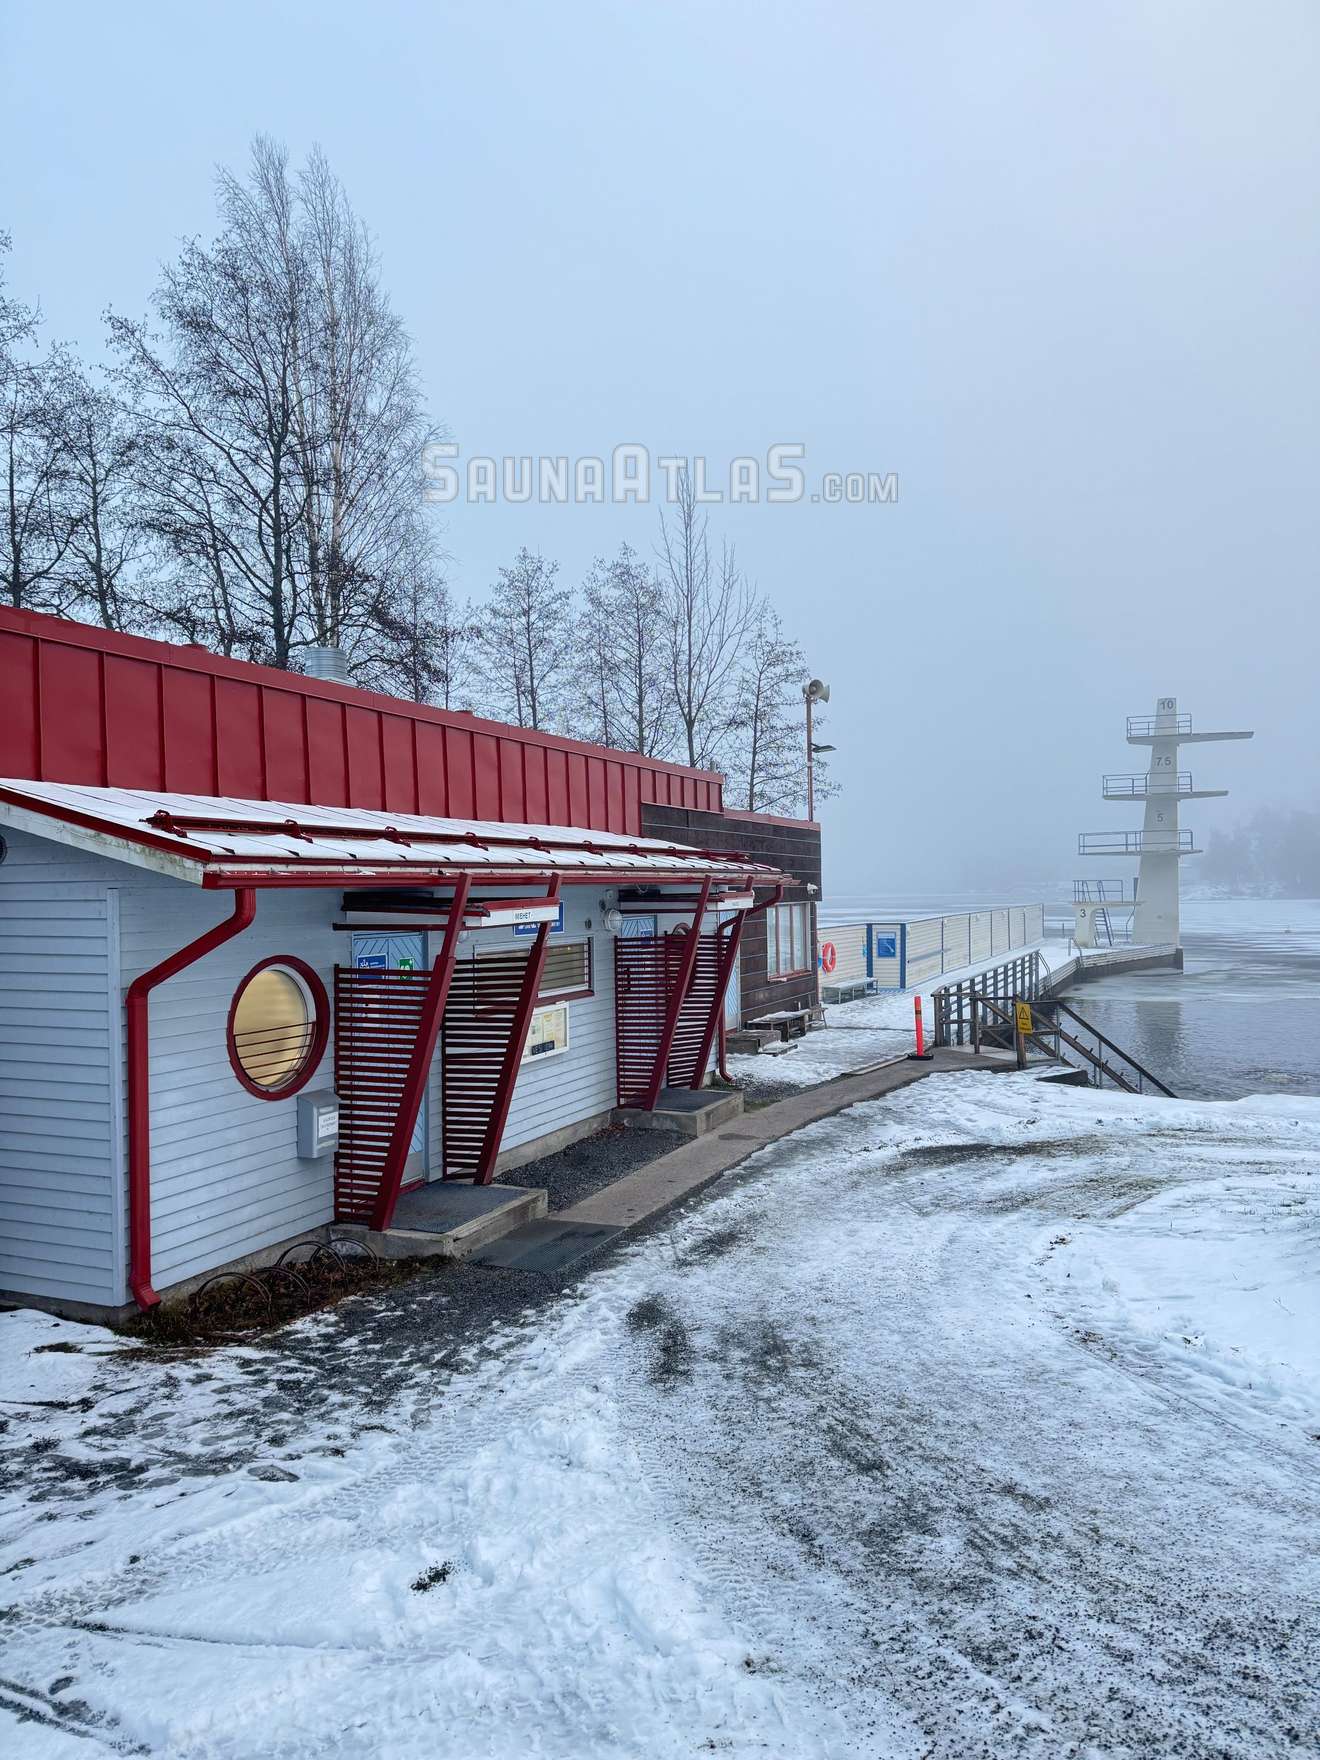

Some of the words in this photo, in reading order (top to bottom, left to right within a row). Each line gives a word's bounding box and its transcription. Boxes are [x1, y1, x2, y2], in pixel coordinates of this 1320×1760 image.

[1160, 700, 1173, 709] 10
[1157, 813, 1164, 822] 5
[1080, 909, 1086, 918] 3
